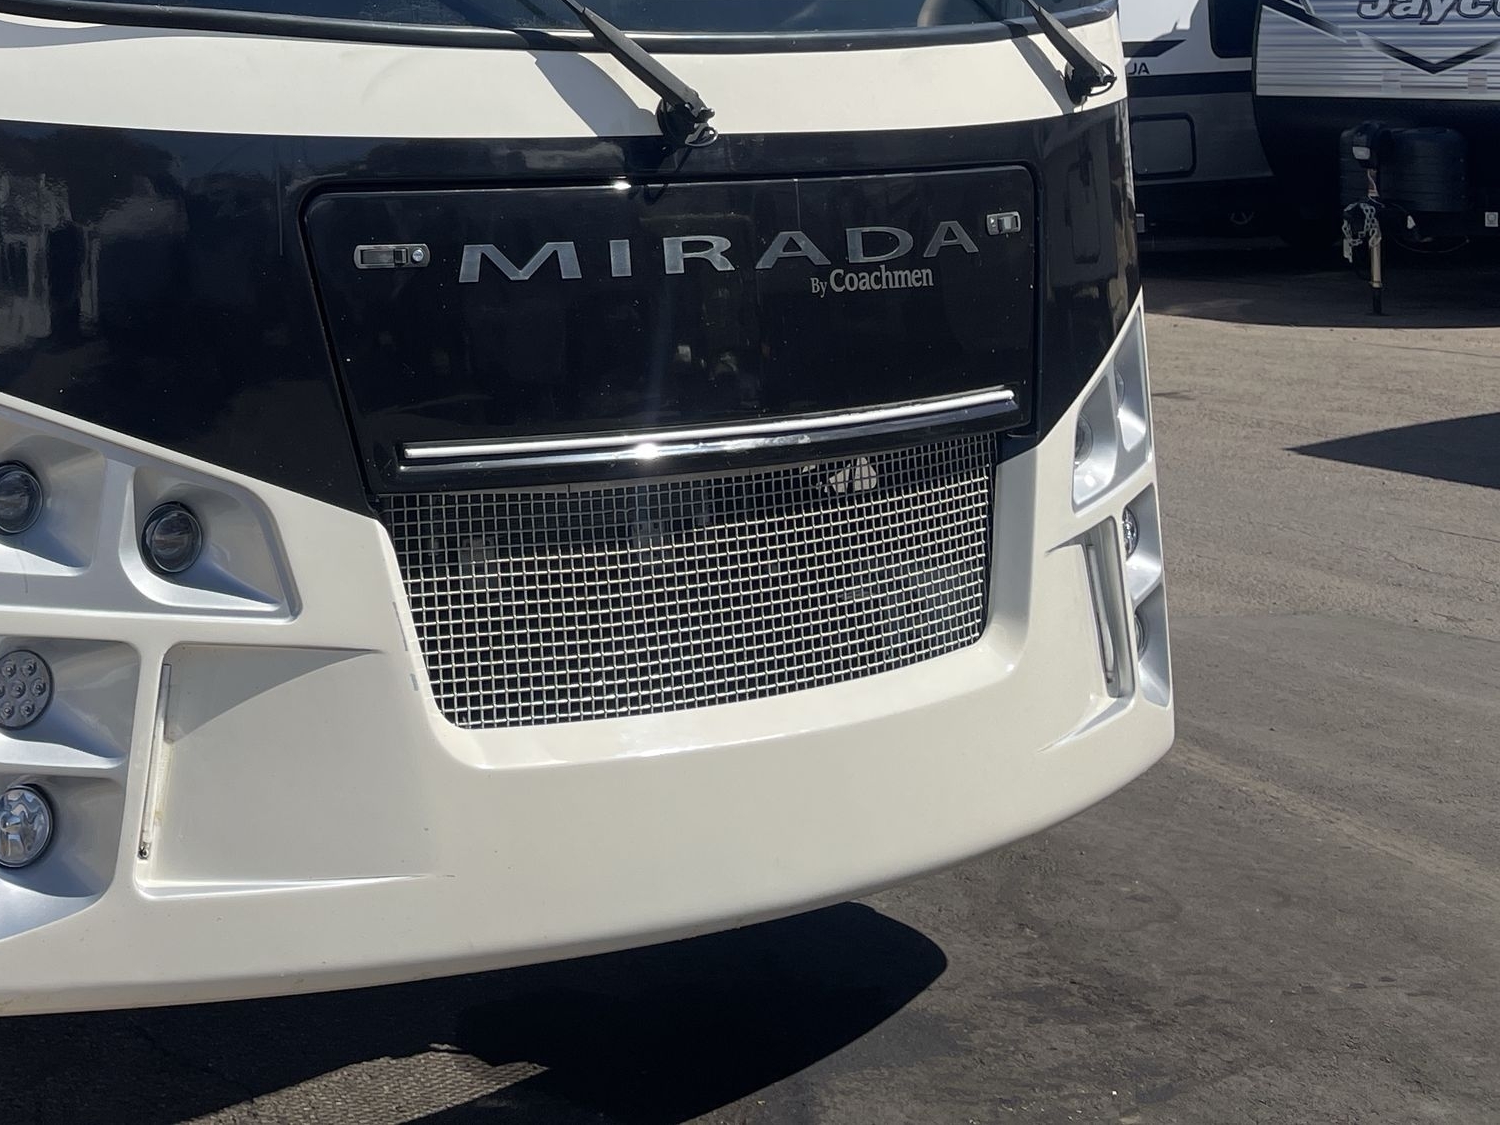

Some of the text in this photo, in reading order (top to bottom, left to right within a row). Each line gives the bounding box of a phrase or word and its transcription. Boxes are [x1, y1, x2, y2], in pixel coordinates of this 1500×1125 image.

[459, 220, 979, 282] MIRADA
[810, 265, 934, 298] By Coachmen
